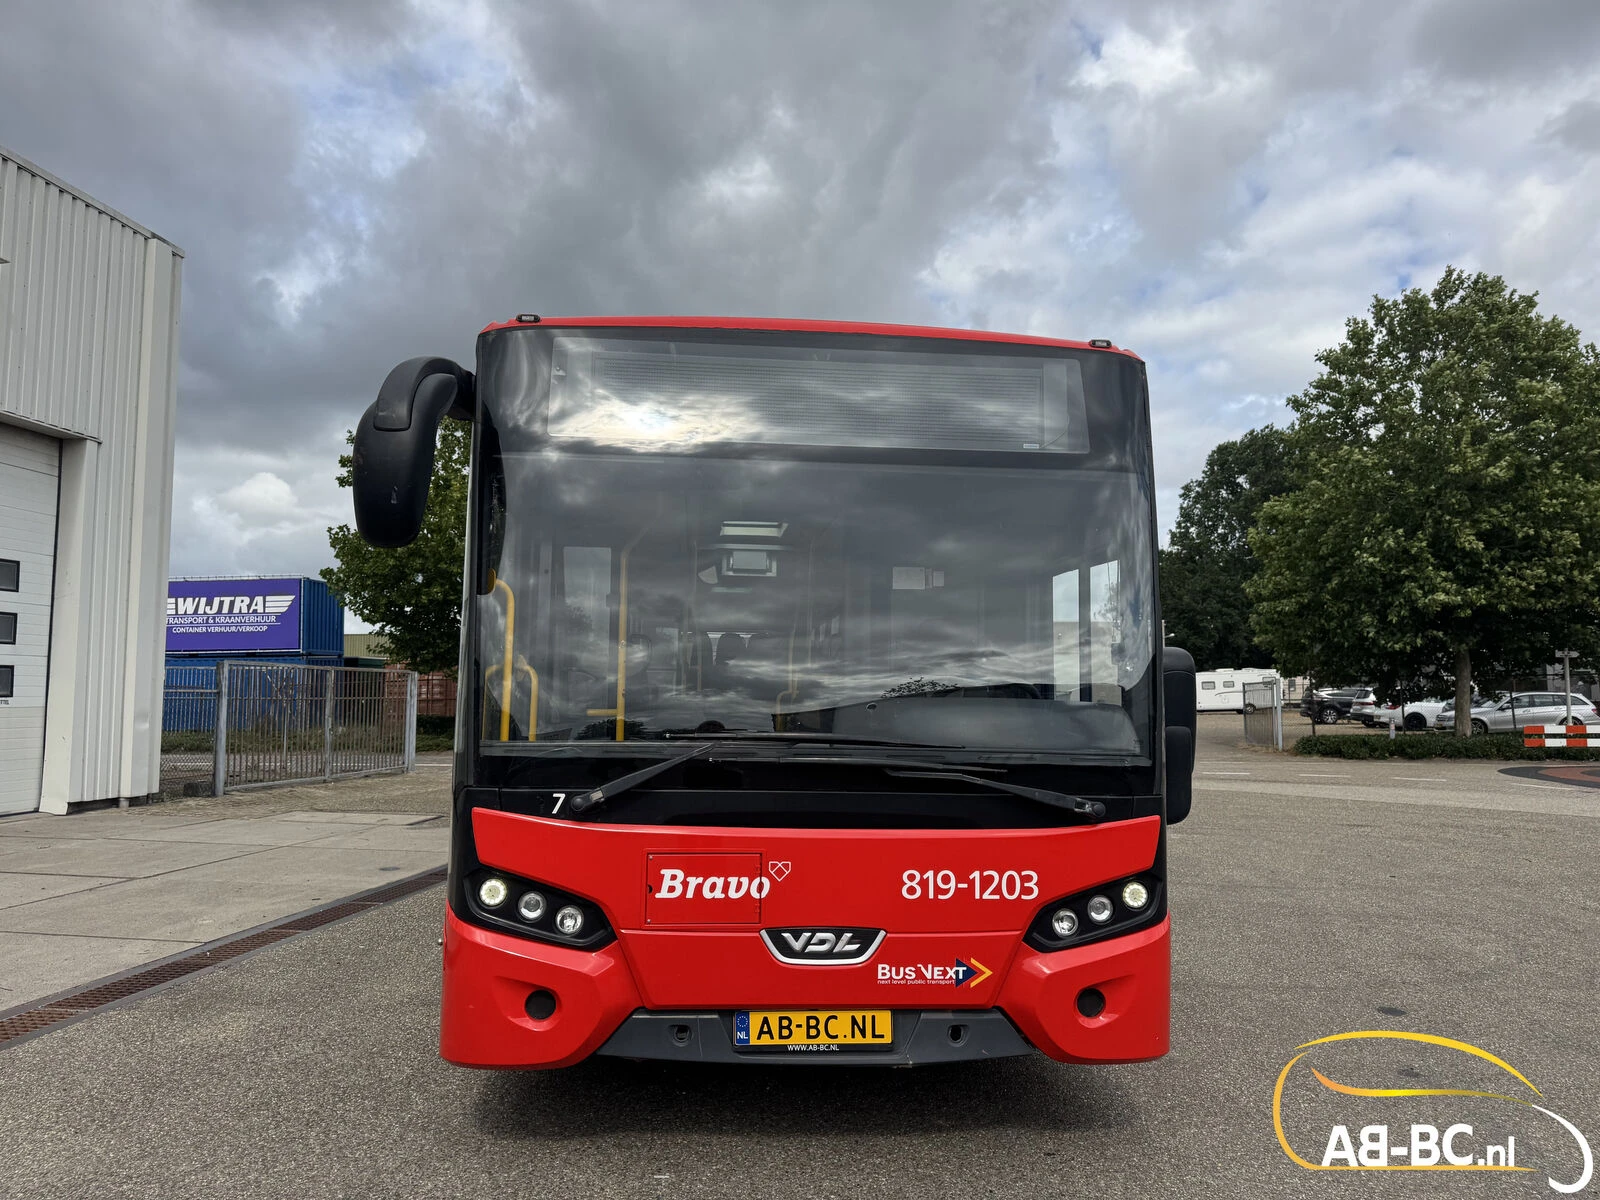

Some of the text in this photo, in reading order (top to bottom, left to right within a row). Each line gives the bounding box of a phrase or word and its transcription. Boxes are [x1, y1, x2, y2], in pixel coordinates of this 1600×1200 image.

[177, 595, 264, 615] WIJTRA
[172, 625, 268, 634] CONTAINER VERHUUR/VERKOOP
[208, 616, 214, 624] &
[215, 615, 277, 624] KRAANVERHUUR
[551, 793, 566, 814] 7
[654, 868, 771, 900] Bravo
[901, 869, 1039, 900] 819-1203
[781, 932, 862, 953] VDL
[737, 1014, 885, 1040] NL AB-BC.NL
[787, 1043, 840, 1051] WWW.AB-BC.NL
